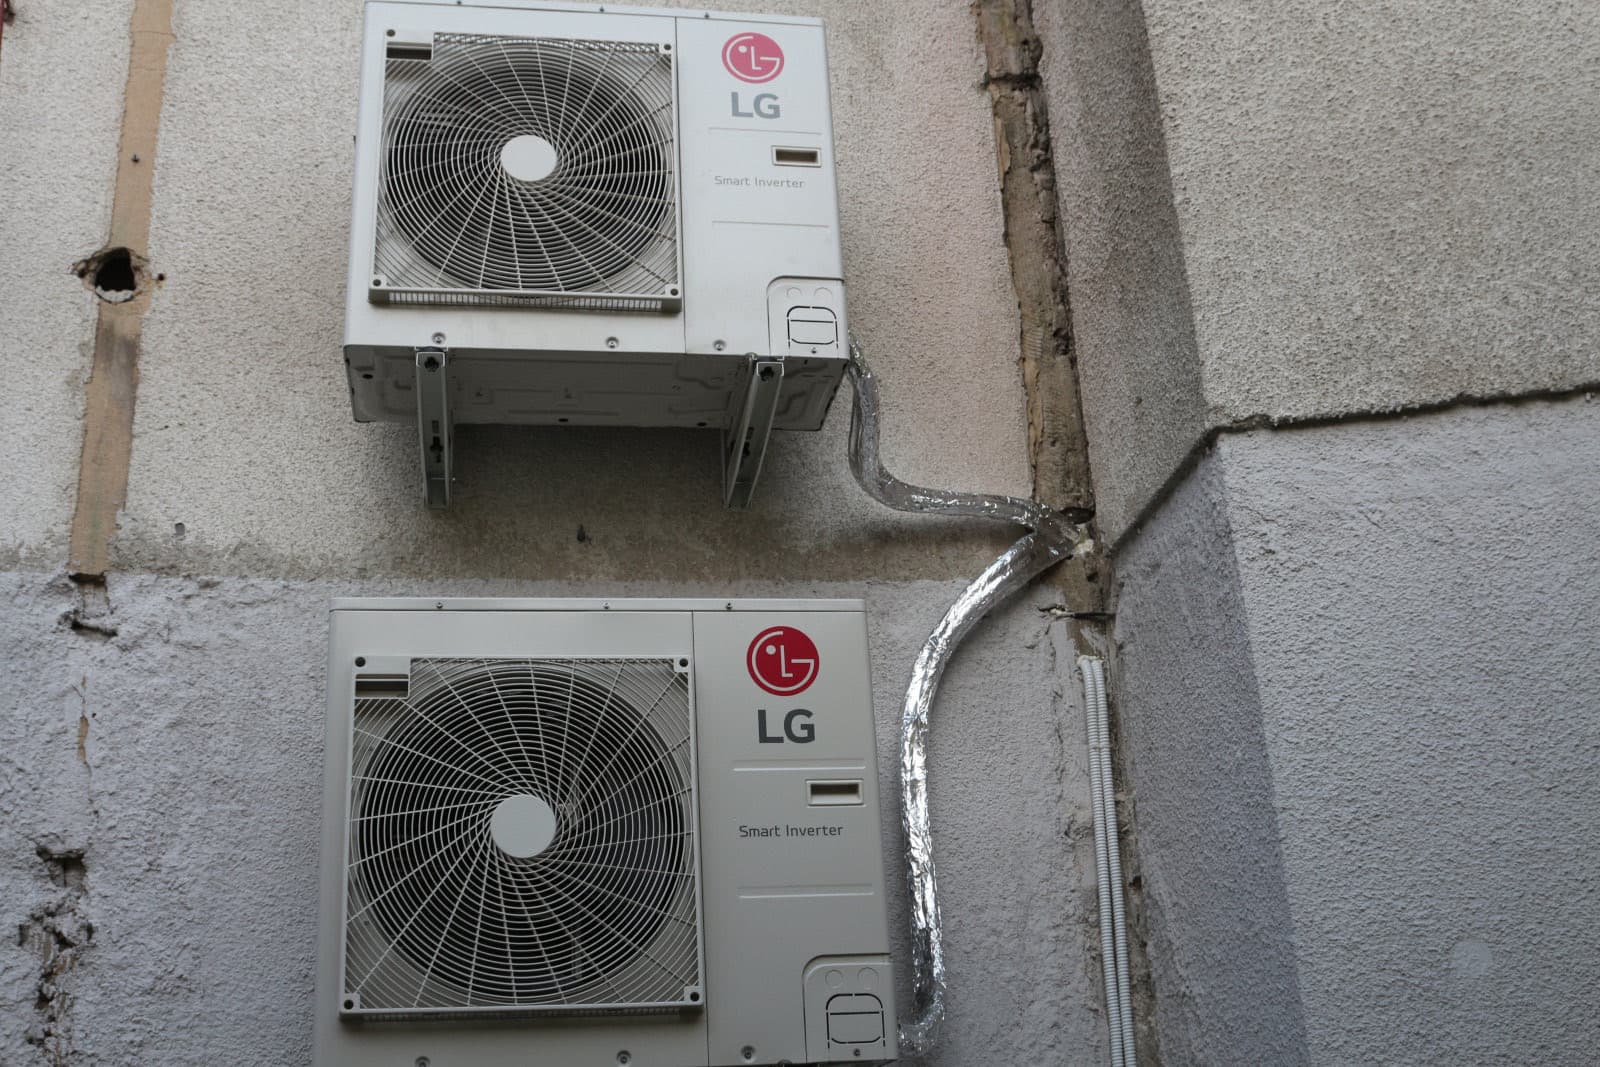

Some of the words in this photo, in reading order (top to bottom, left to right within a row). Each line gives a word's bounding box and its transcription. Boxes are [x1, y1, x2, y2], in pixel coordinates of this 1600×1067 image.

[731, 91, 781, 119] LG
[714, 175, 750, 187] Smart
[754, 176, 805, 189] Inverter
[757, 708, 816, 744] LG
[738, 824, 781, 838] Smart
[785, 823, 844, 838] Inverter
